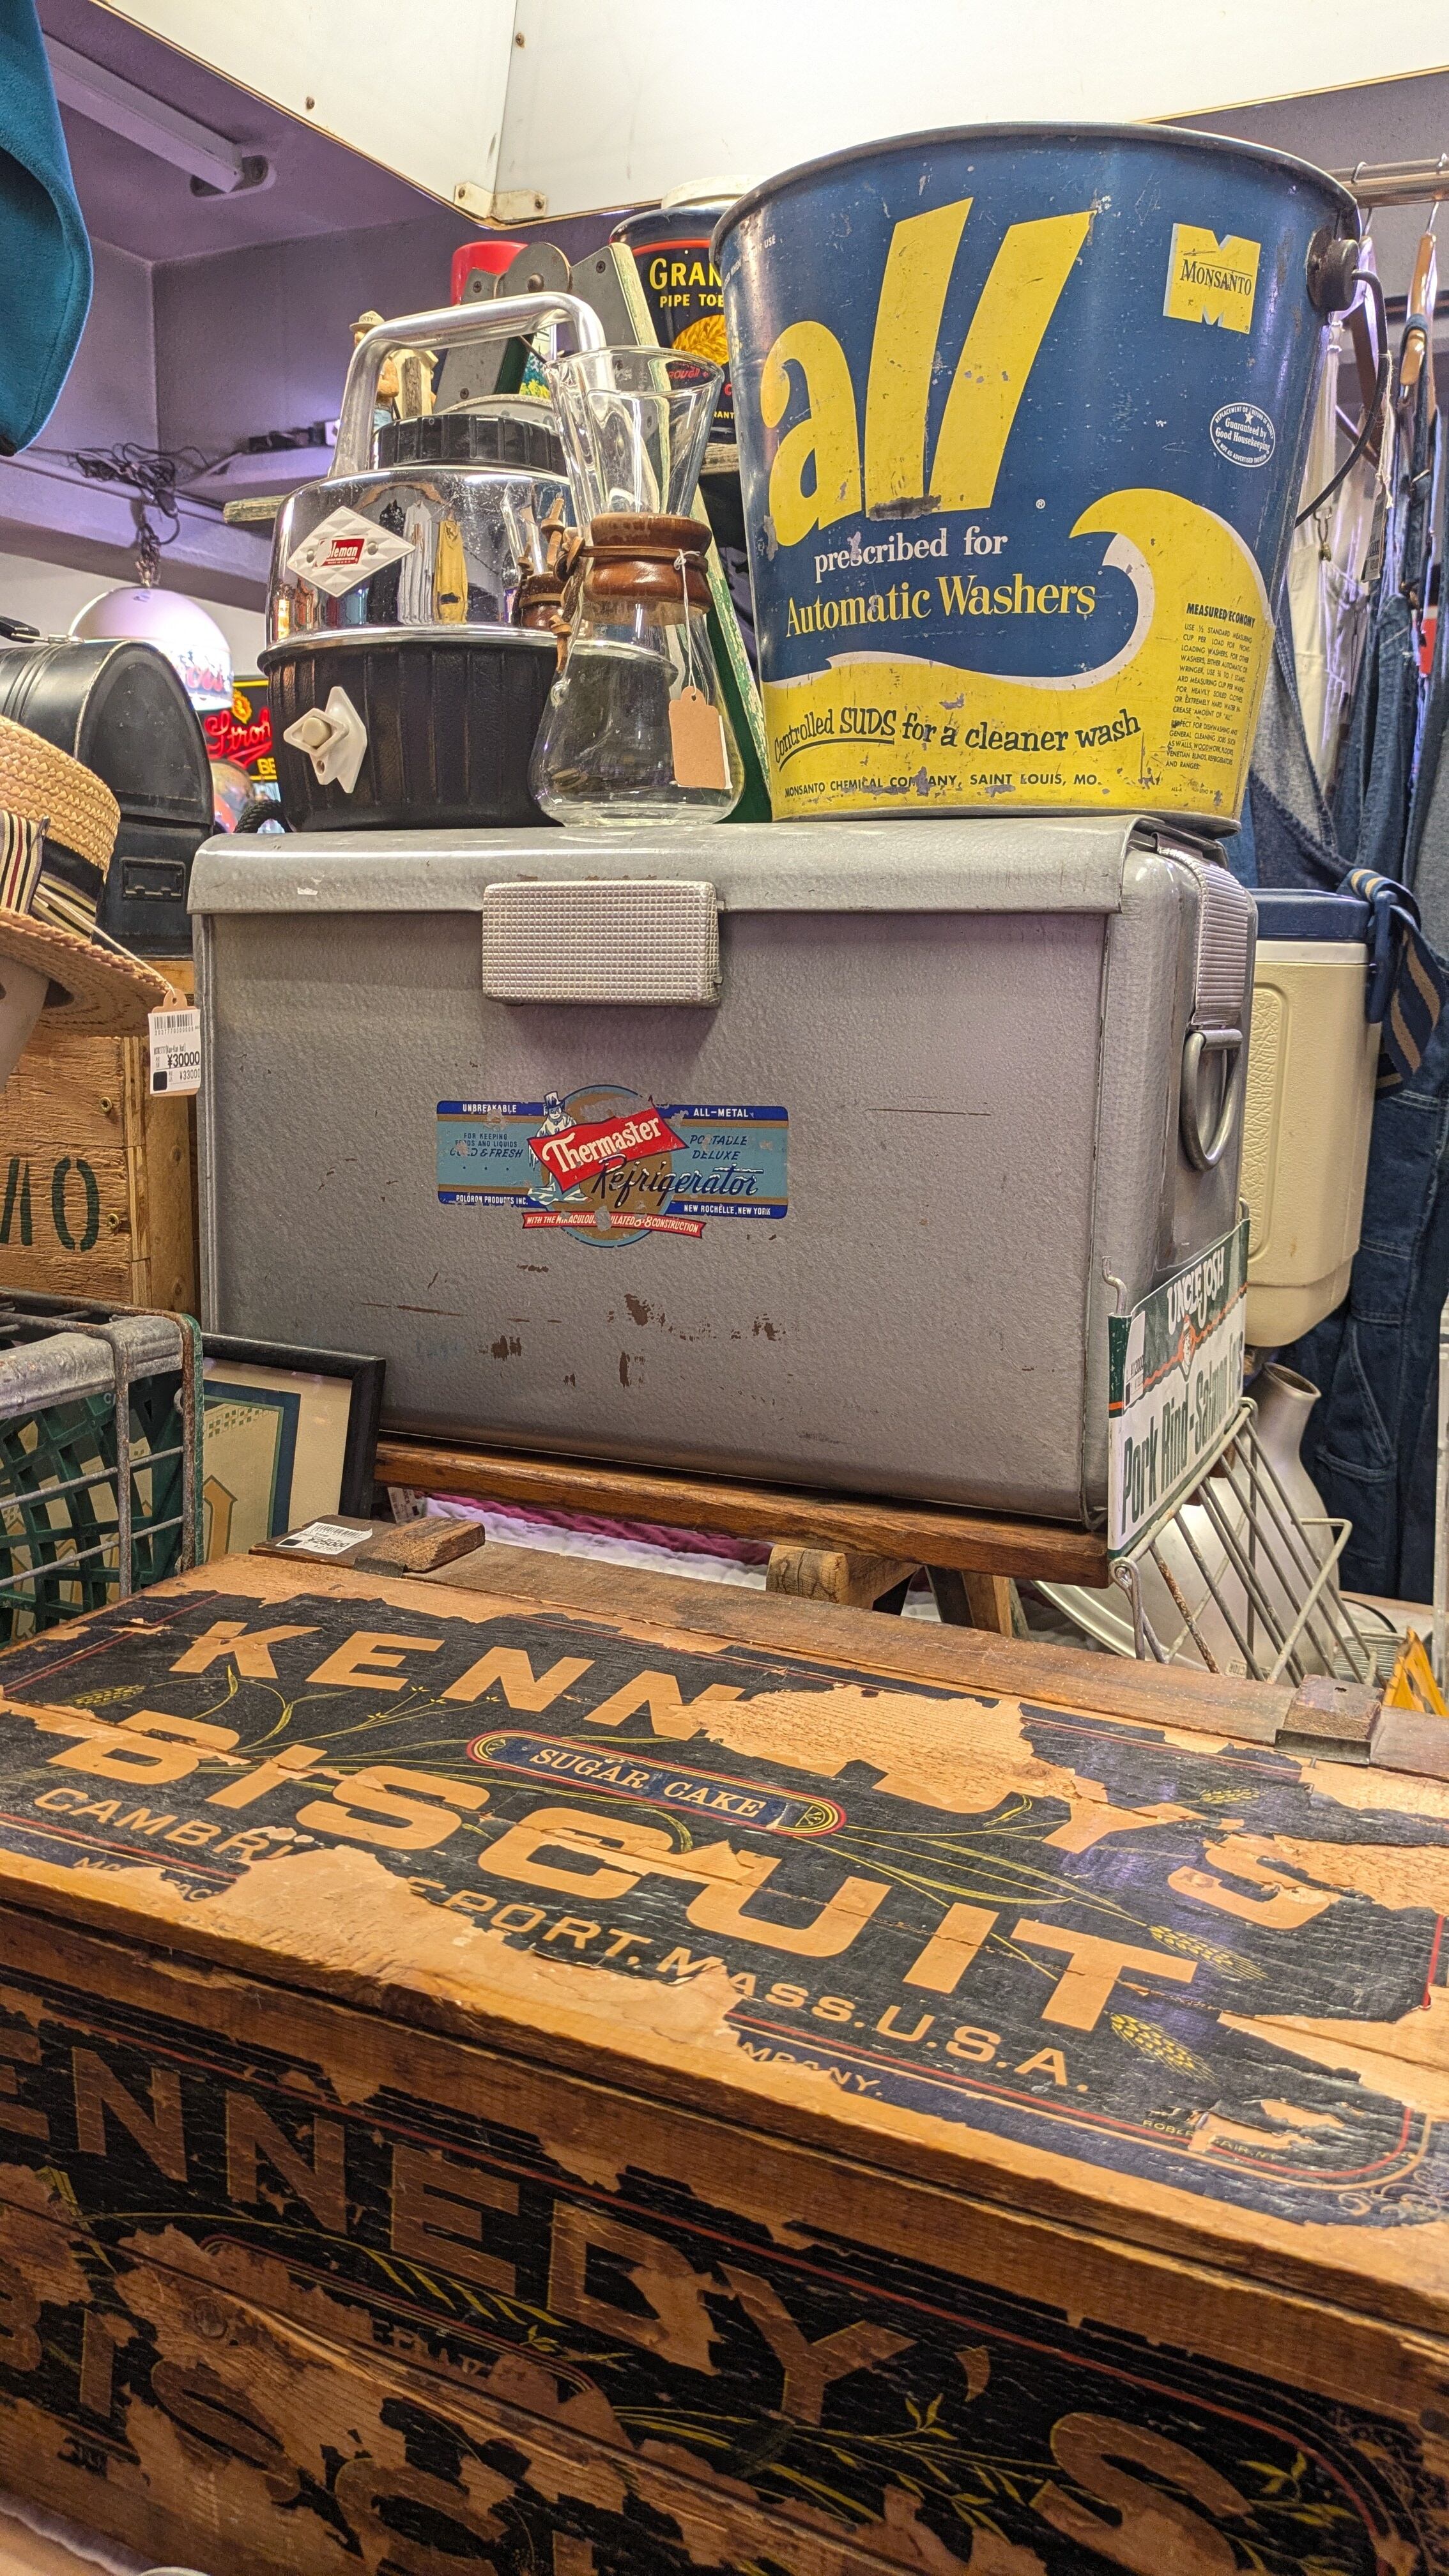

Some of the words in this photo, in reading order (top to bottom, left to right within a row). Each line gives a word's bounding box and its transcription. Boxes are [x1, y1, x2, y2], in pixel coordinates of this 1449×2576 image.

[1179, 258, 1253, 296] MONSANTO
[660, 294, 690, 308] PIPE
[760, 197, 1098, 546] all
[1225, 417, 1259, 436] Guaranteed
[1260, 427, 1267, 441] by
[1216, 427, 1232, 440] Good
[1233, 431, 1270, 454] Housekeeping
[814, 528, 948, 583] prescribed
[963, 526, 1008, 556] for
[786, 582, 932, 638] Automatic
[935, 574, 1097, 617] Washers
[1186, 603, 1227, 620] MEASURED
[1229, 611, 1255, 629] ECONOMY
[1208, 627, 1230, 637] STANDARD
[1232, 632, 1252, 643] MEASURING
[1181, 645, 1205, 654] LOADING
[1239, 655, 1249, 663] OTHER
[1222, 661, 1243, 672] AUTOMATIC
[1190, 677, 1216, 687] MEASURING
[1185, 696, 1210, 705] EXTREMELY
[1192, 687, 1210, 696] HEAVILY
[1213, 691, 1227, 699] SOILED
[1229, 694, 1243, 703] CLOTHES
[773, 709, 833, 764] Controlled
[840, 707, 896, 737] SUDS
[902, 712, 936, 743] for
[941, 724, 958, 747] a
[965, 722, 1068, 753] cleaner
[1075, 709, 1141, 749] wash
[1195, 733, 1215, 741] CLEANING
[1204, 723, 1230, 734] DISHWASHING
[1176, 740, 1193, 749] WALLS,
[1208, 755, 1233, 765] REFRIGERATORS
[785, 782, 825, 797] MONSANTO
[830, 777, 883, 792] CHEMICAL
[889, 774, 960, 790] COMANY,
[970, 774, 1013, 786] SAINT
[1020, 774, 1066, 786] LOUIS,
[1073, 774, 1102, 786] MO.
[167, 1051, 200, 1068] ¥30000
[180, 1068, 200, 1080] ¥33000
[693, 1108, 749, 1118] ALL-METAL
[542, 1117, 661, 1174] Thermaster
[689, 1135, 747, 1146] POTABLE
[450, 1148, 478, 1156] CD
[489, 1149, 523, 1158] FRESH
[692, 1151, 740, 1160] DELUXE
[591, 1153, 764, 1209] Refrigerator
[684, 1204, 698, 1213] NEW
[738, 1206, 752, 1215] NEW
[753, 1207, 770, 1216] YORK
[526, 1215, 542, 1225] WITH
[543, 1215, 555, 1224] THE
[652, 1216, 698, 1232] CONSTRUCTION
[1167, 1269, 1202, 1335] UNCLE
[1199, 1246, 1225, 1329] JOSH
[1121, 1416, 1159, 1537] Pork
[169, 1621, 1342, 1929] KENNYS
[529, 1749, 650, 1789] SUGAR
[663, 1781, 767, 1819] CAKE
[47, 1710, 1199, 2032] BISCUIT
